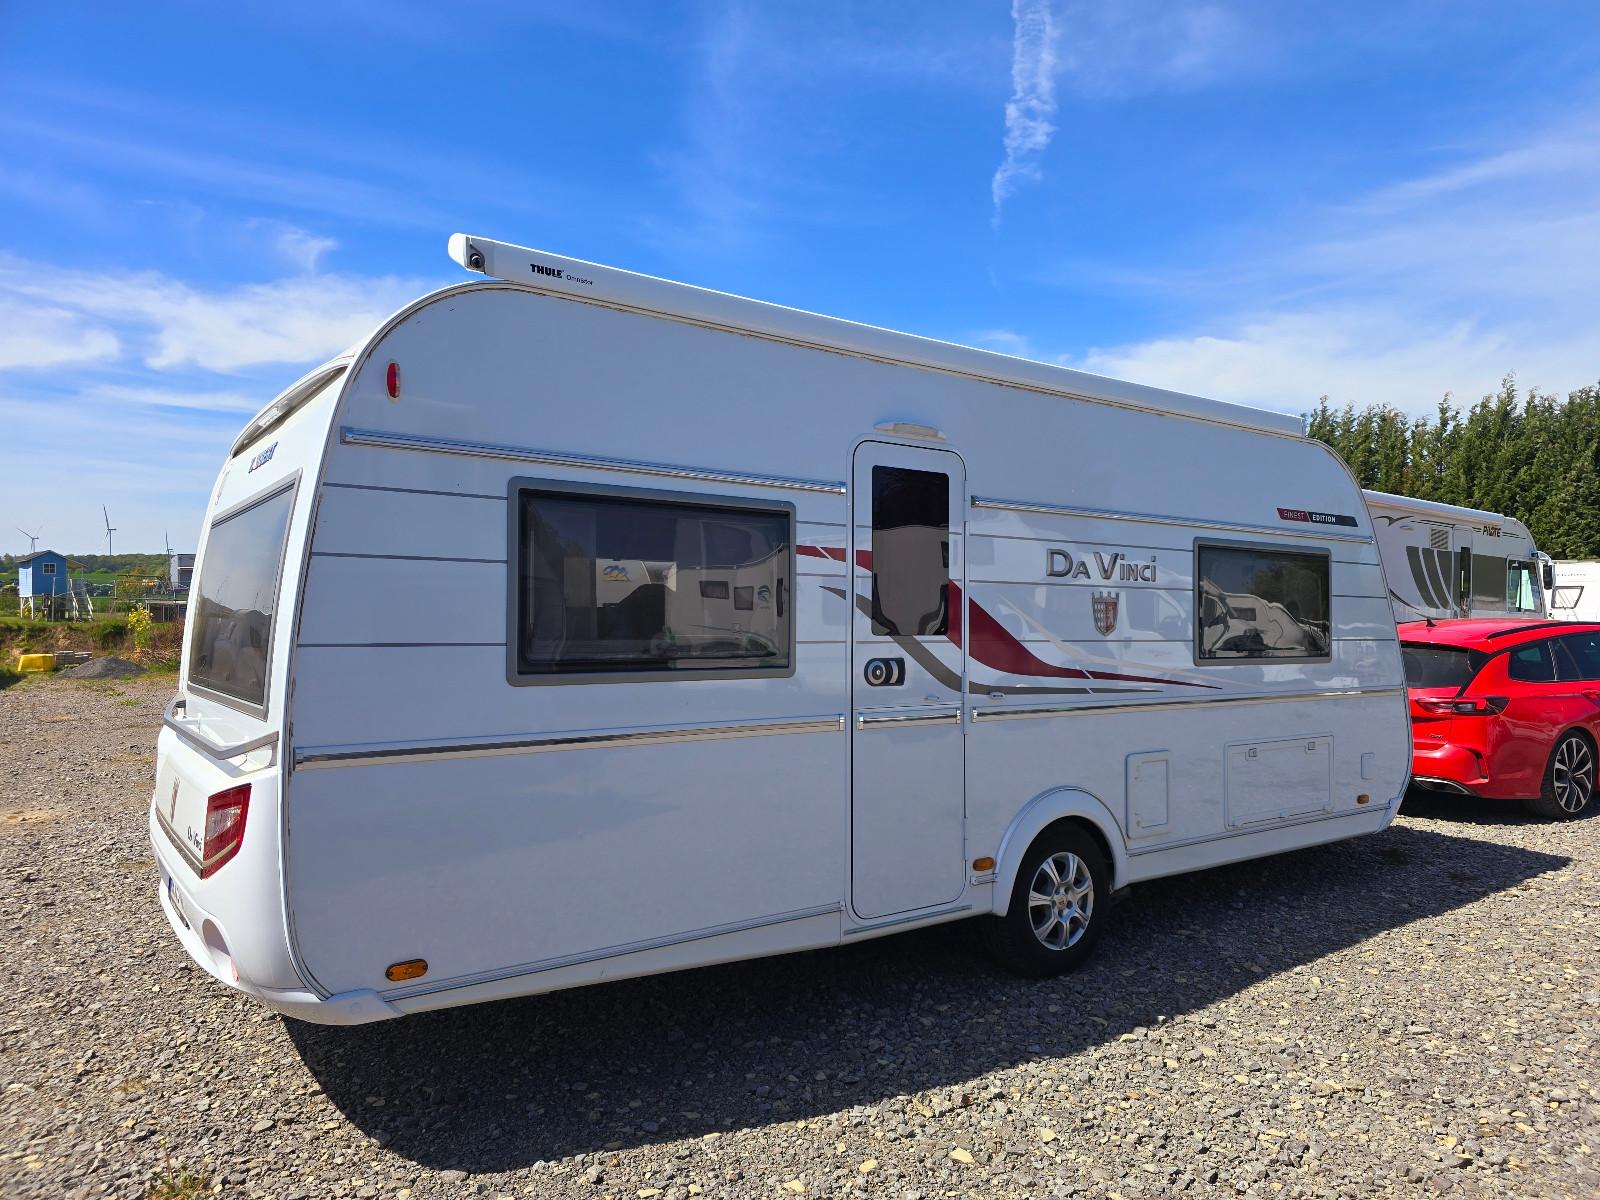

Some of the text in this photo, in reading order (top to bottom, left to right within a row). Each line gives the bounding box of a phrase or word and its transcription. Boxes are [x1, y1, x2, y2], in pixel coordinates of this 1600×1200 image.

[530, 263, 563, 279] THULE
[1283, 510, 1336, 523] FINEST EDITION
